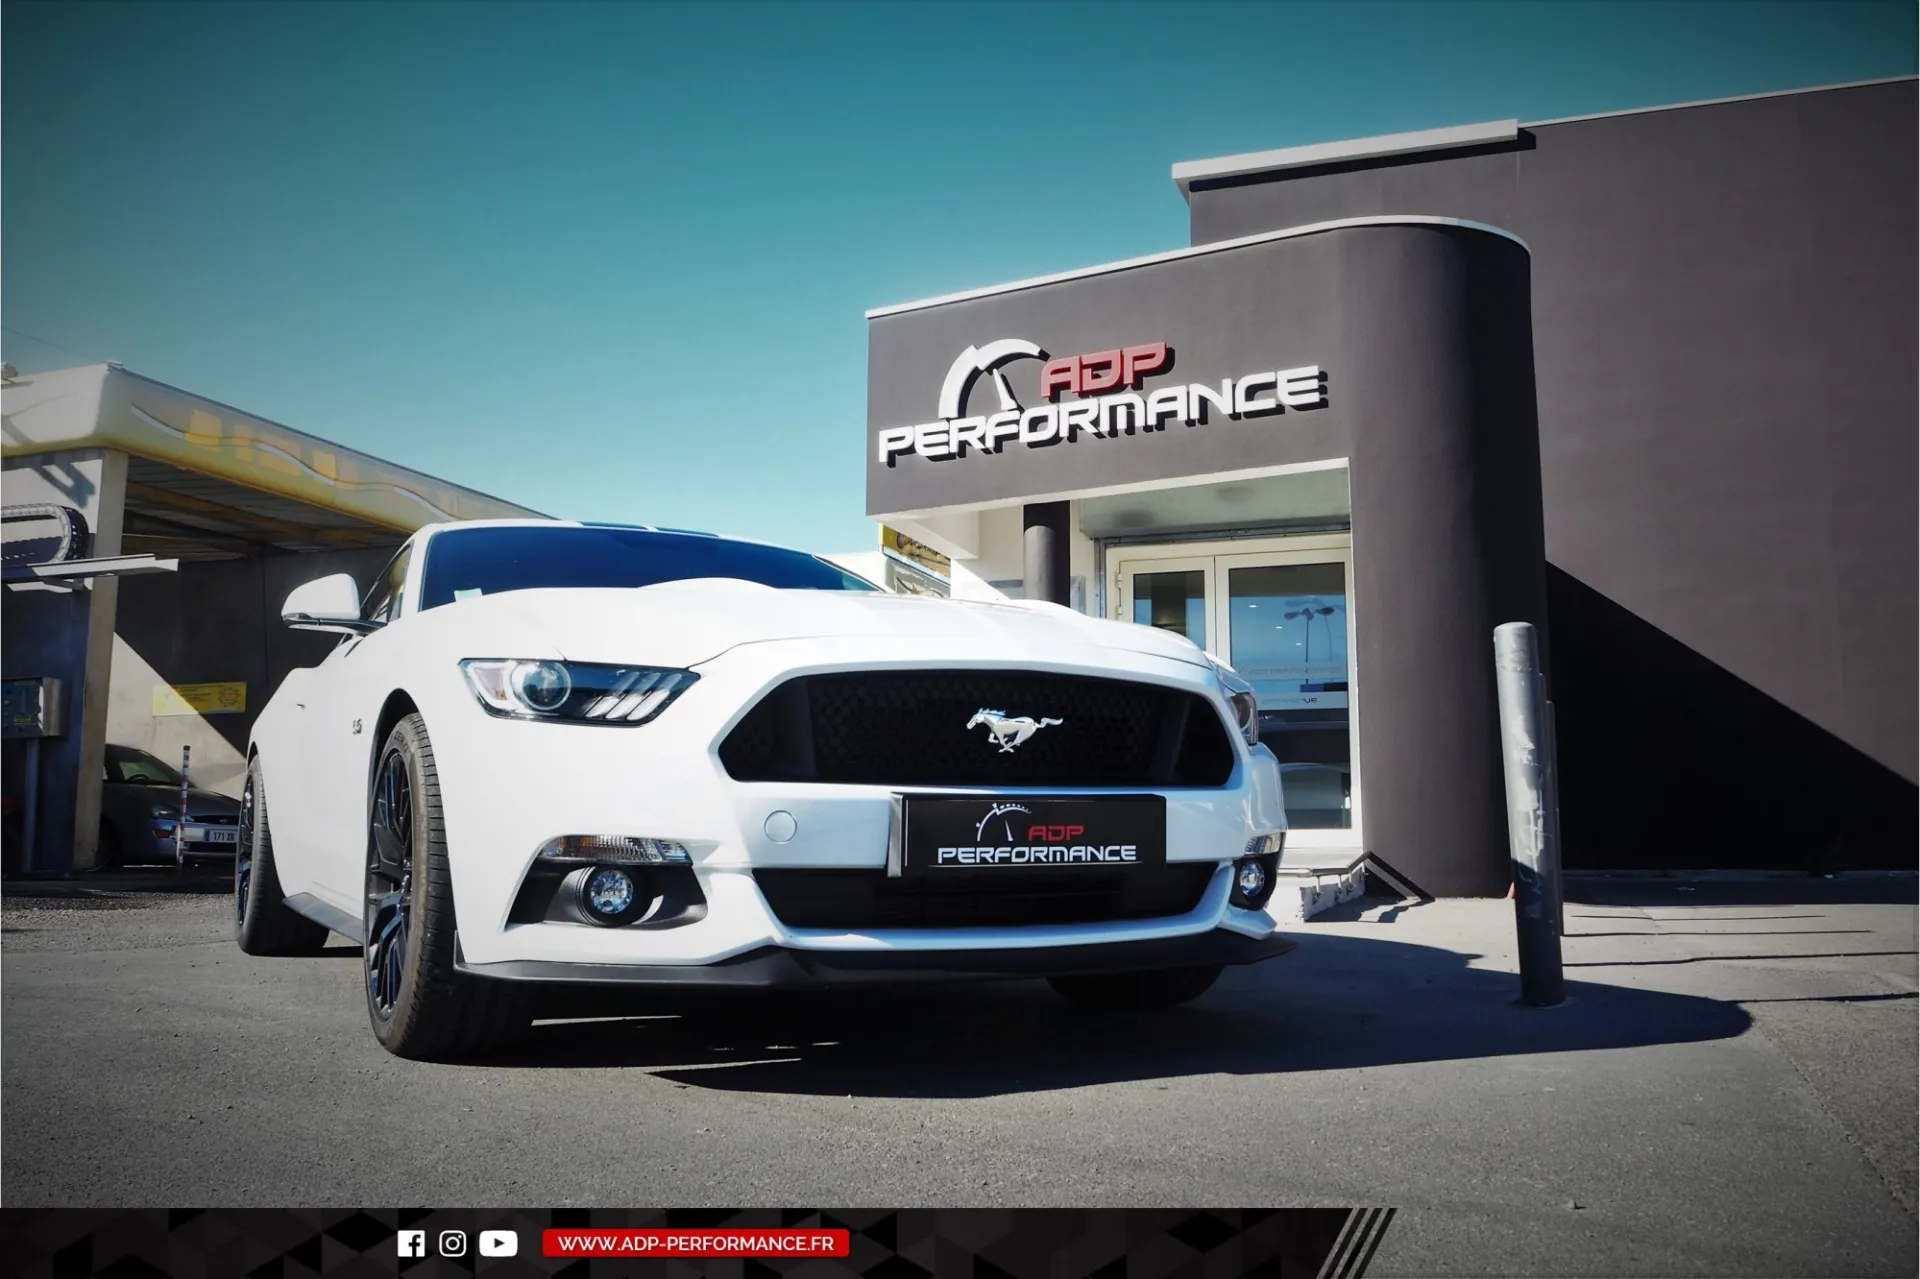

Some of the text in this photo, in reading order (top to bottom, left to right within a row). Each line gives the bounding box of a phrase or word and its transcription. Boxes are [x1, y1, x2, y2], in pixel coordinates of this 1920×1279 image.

[1040, 342, 1167, 398] ADP
[879, 365, 1320, 463] PERFORMANCE
[1028, 825, 1085, 841] ADP
[937, 845, 1137, 864] PERFORMANCE
